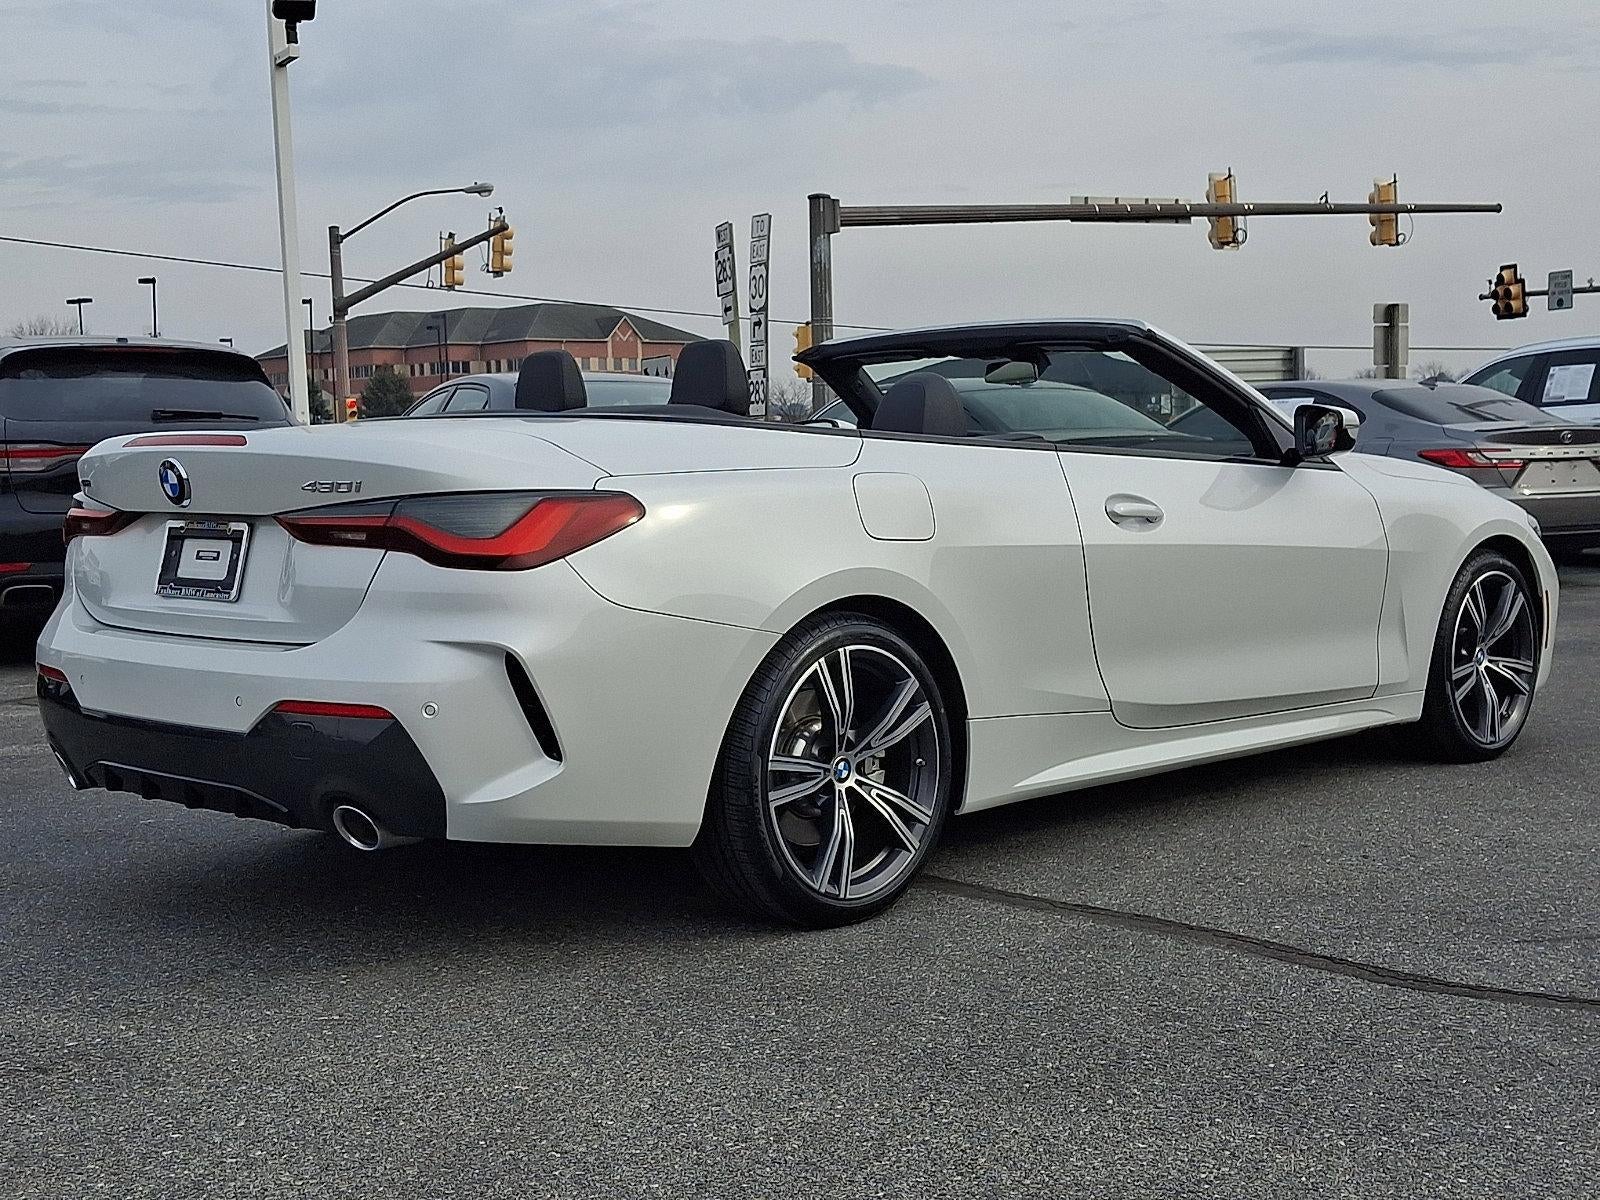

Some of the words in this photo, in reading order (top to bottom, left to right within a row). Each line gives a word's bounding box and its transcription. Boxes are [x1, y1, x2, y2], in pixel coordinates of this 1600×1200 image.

[756, 219, 765, 233] TO
[752, 244, 765, 259] EAST
[716, 256, 732, 284] 283
[751, 274, 765, 300] 30
[752, 348, 764, 364] EAST
[749, 380, 765, 405] 283
[301, 480, 362, 493] 430i
[181, 588, 196, 597] BMW
